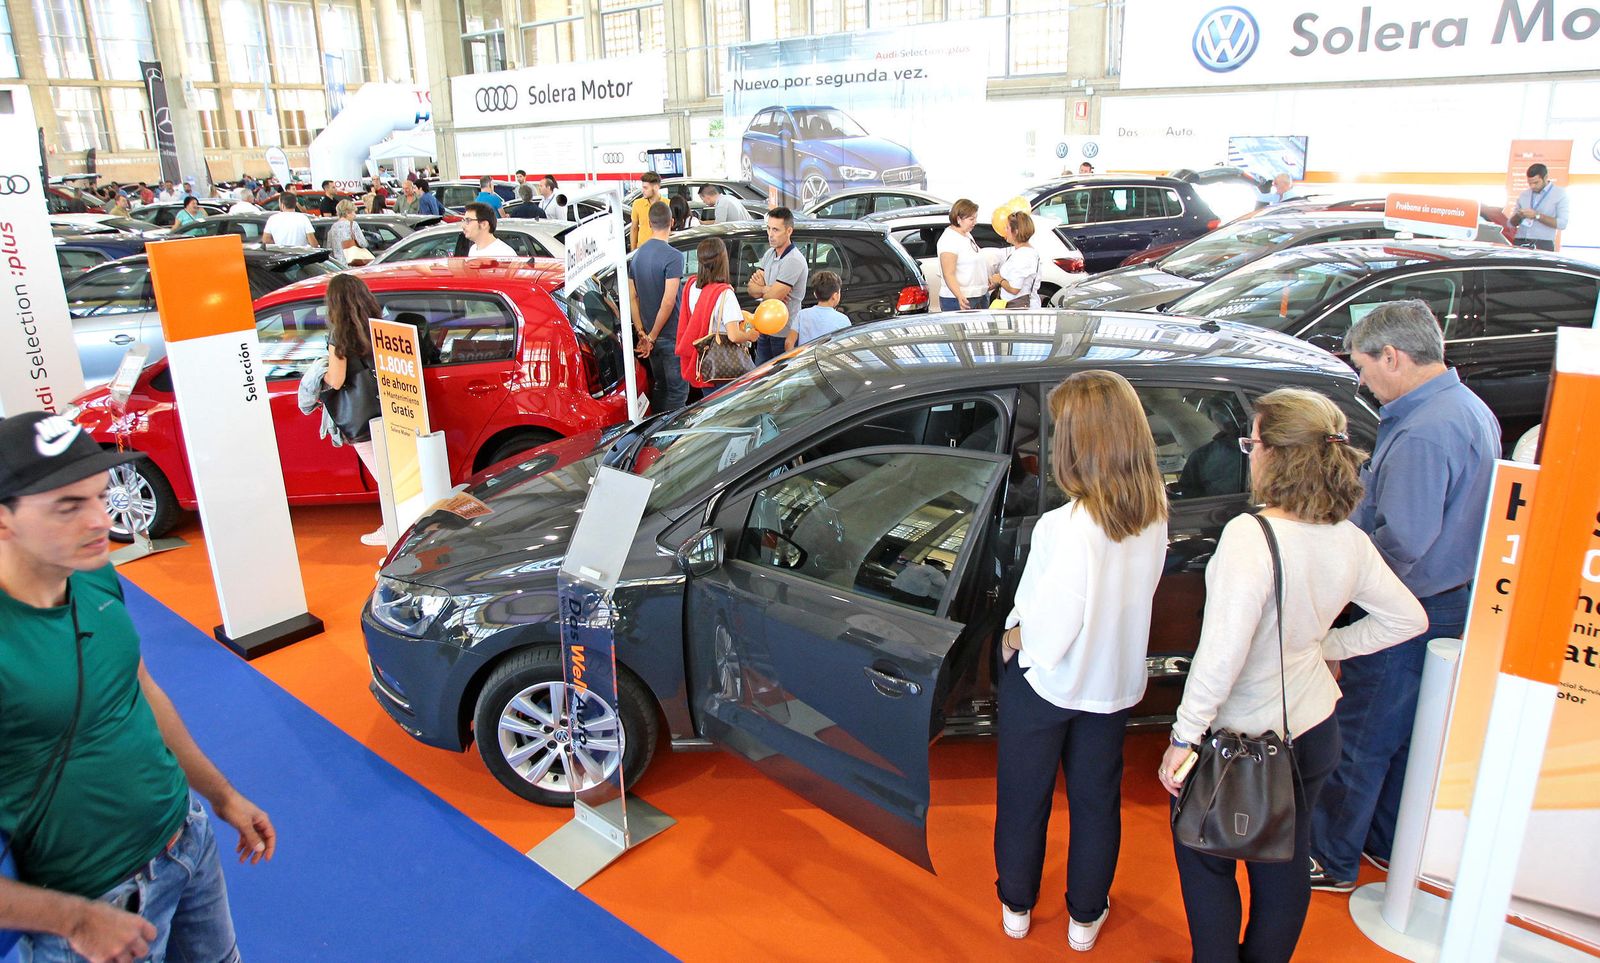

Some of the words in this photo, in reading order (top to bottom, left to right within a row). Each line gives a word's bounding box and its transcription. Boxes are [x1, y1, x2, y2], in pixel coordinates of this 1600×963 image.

[1288, 6, 1468, 57] Solera
[1489, 0, 1600, 44] Mo
[875, 51, 897, 61] Audi
[733, 79, 779, 91] Nuevo
[784, 77, 811, 90] por
[816, 68, 888, 87] segunda
[894, 68, 928, 80] vez.
[528, 83, 576, 105] Solera
[582, 79, 633, 100] Motor
[1118, 127, 1138, 137] Das
[334, 180, 362, 189] OYOTA
[15, 283, 47, 380] Selection
[373, 328, 413, 355] Hasta
[240, 343, 258, 402] Selección
[379, 354, 416, 378] 1.800€
[382, 375, 391, 387] de
[392, 378, 418, 394] ahorro
[35, 386, 56, 414] udi
[391, 402, 415, 418] Gratis
[569, 598, 582, 640] Das
[1557, 691, 1587, 704] otor
